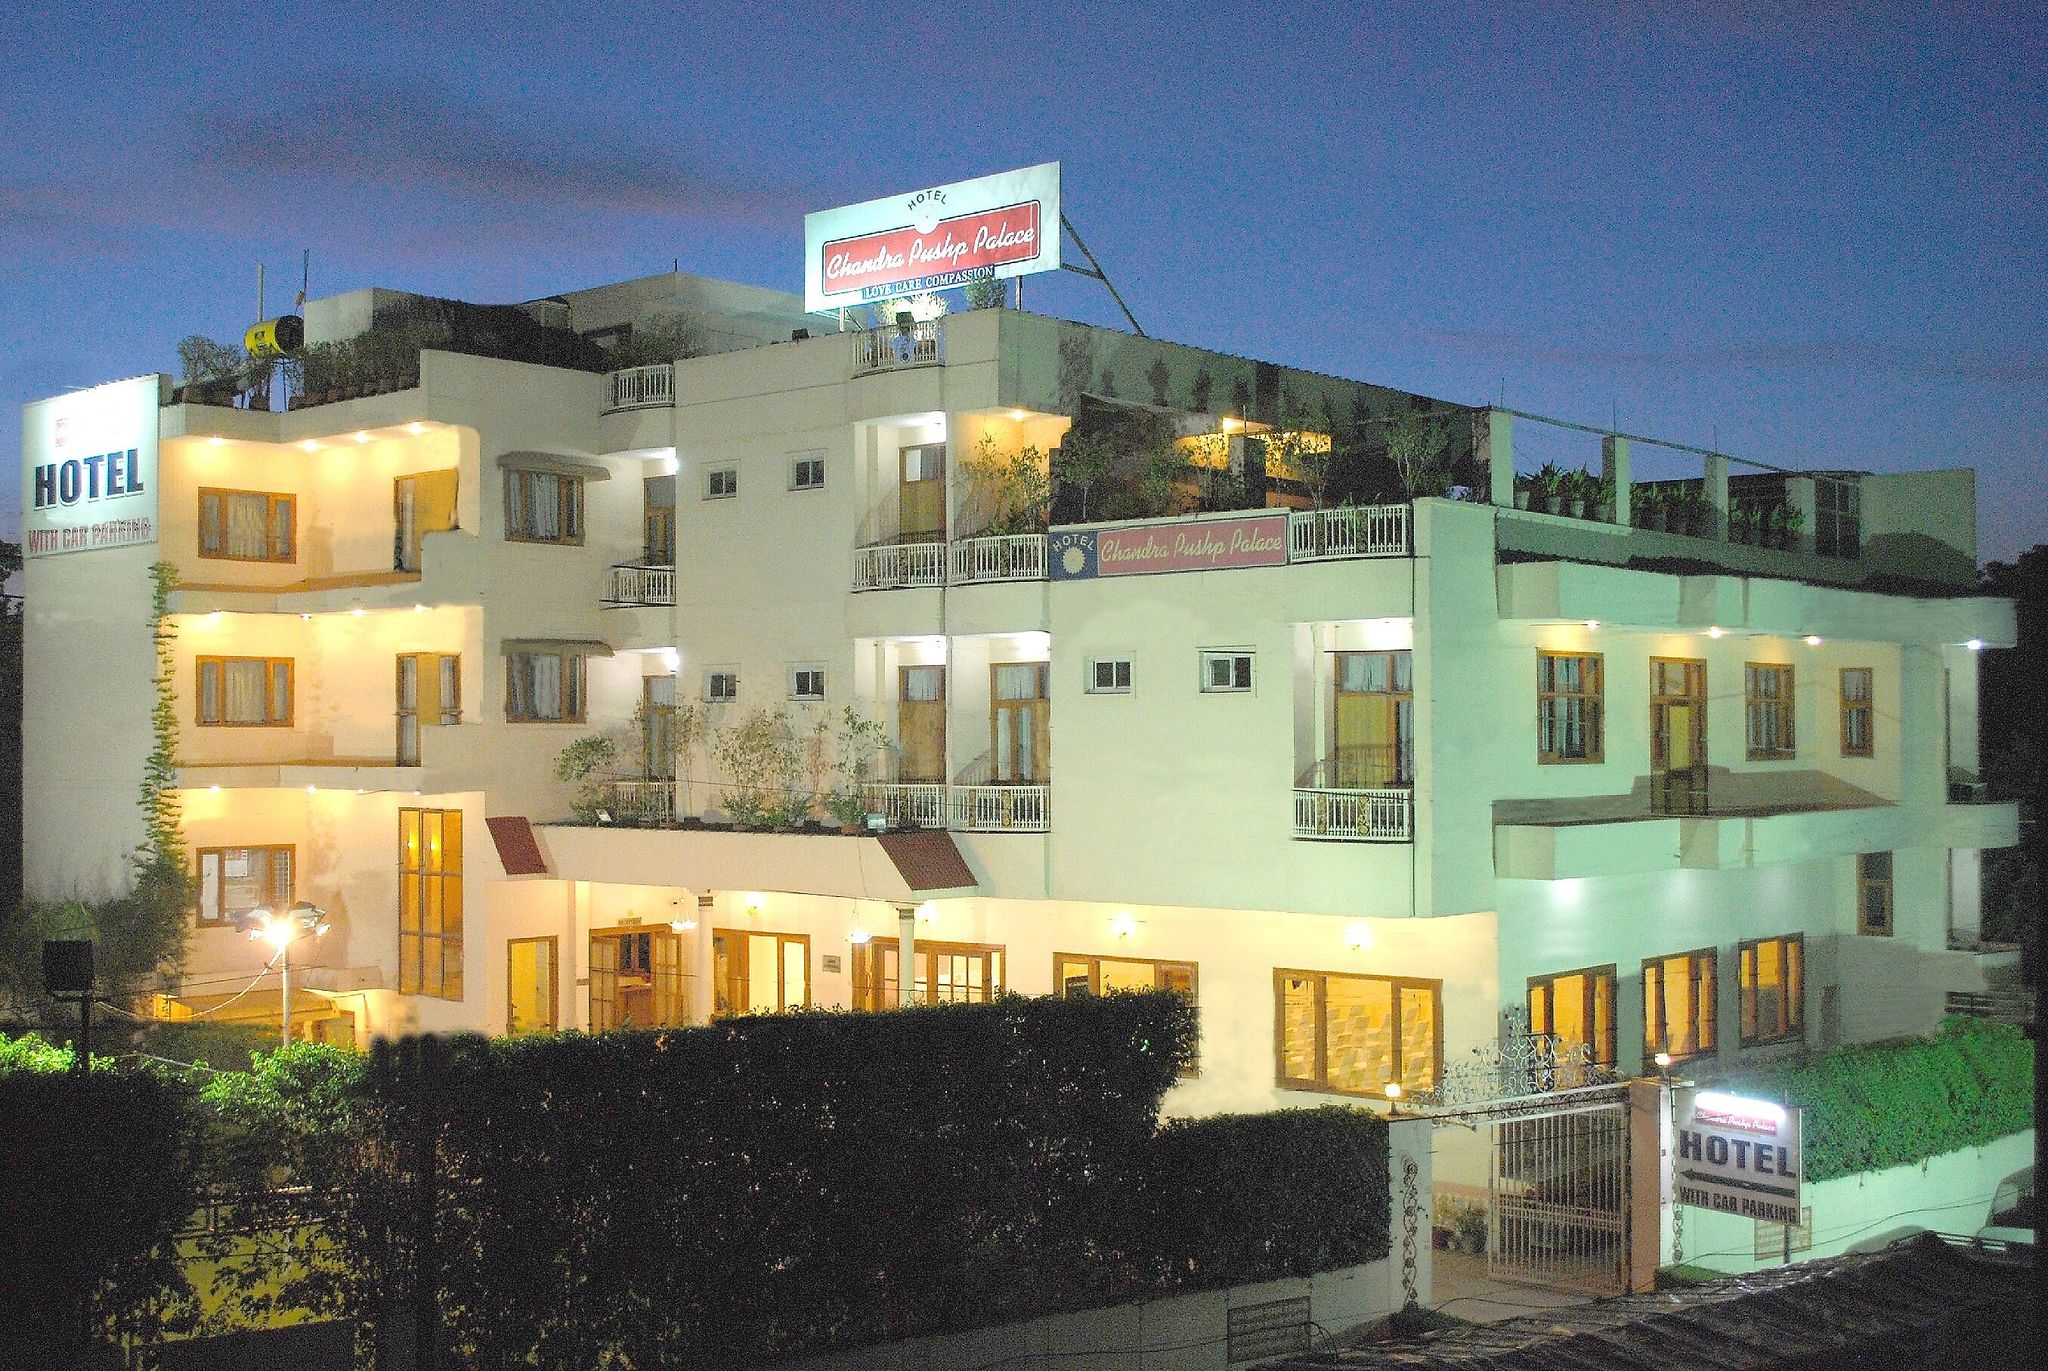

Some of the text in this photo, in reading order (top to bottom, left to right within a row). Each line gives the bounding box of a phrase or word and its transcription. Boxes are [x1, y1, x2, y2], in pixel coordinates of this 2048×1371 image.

[908, 190, 947, 211] HOTEL
[827, 221, 1035, 279] Chandra Pushp Palace
[865, 265, 995, 298] LOVE CARE COMPASSION
[34, 448, 144, 508] HOTEL
[29, 516, 150, 553] WITH CAR PARKING
[1052, 533, 1095, 551] HOTEL
[1100, 526, 1283, 563] Chandra Pushp Palace
[1679, 1130, 1797, 1178] HOTEL
[1680, 1186, 1797, 1225] WITH CAR PARKING
